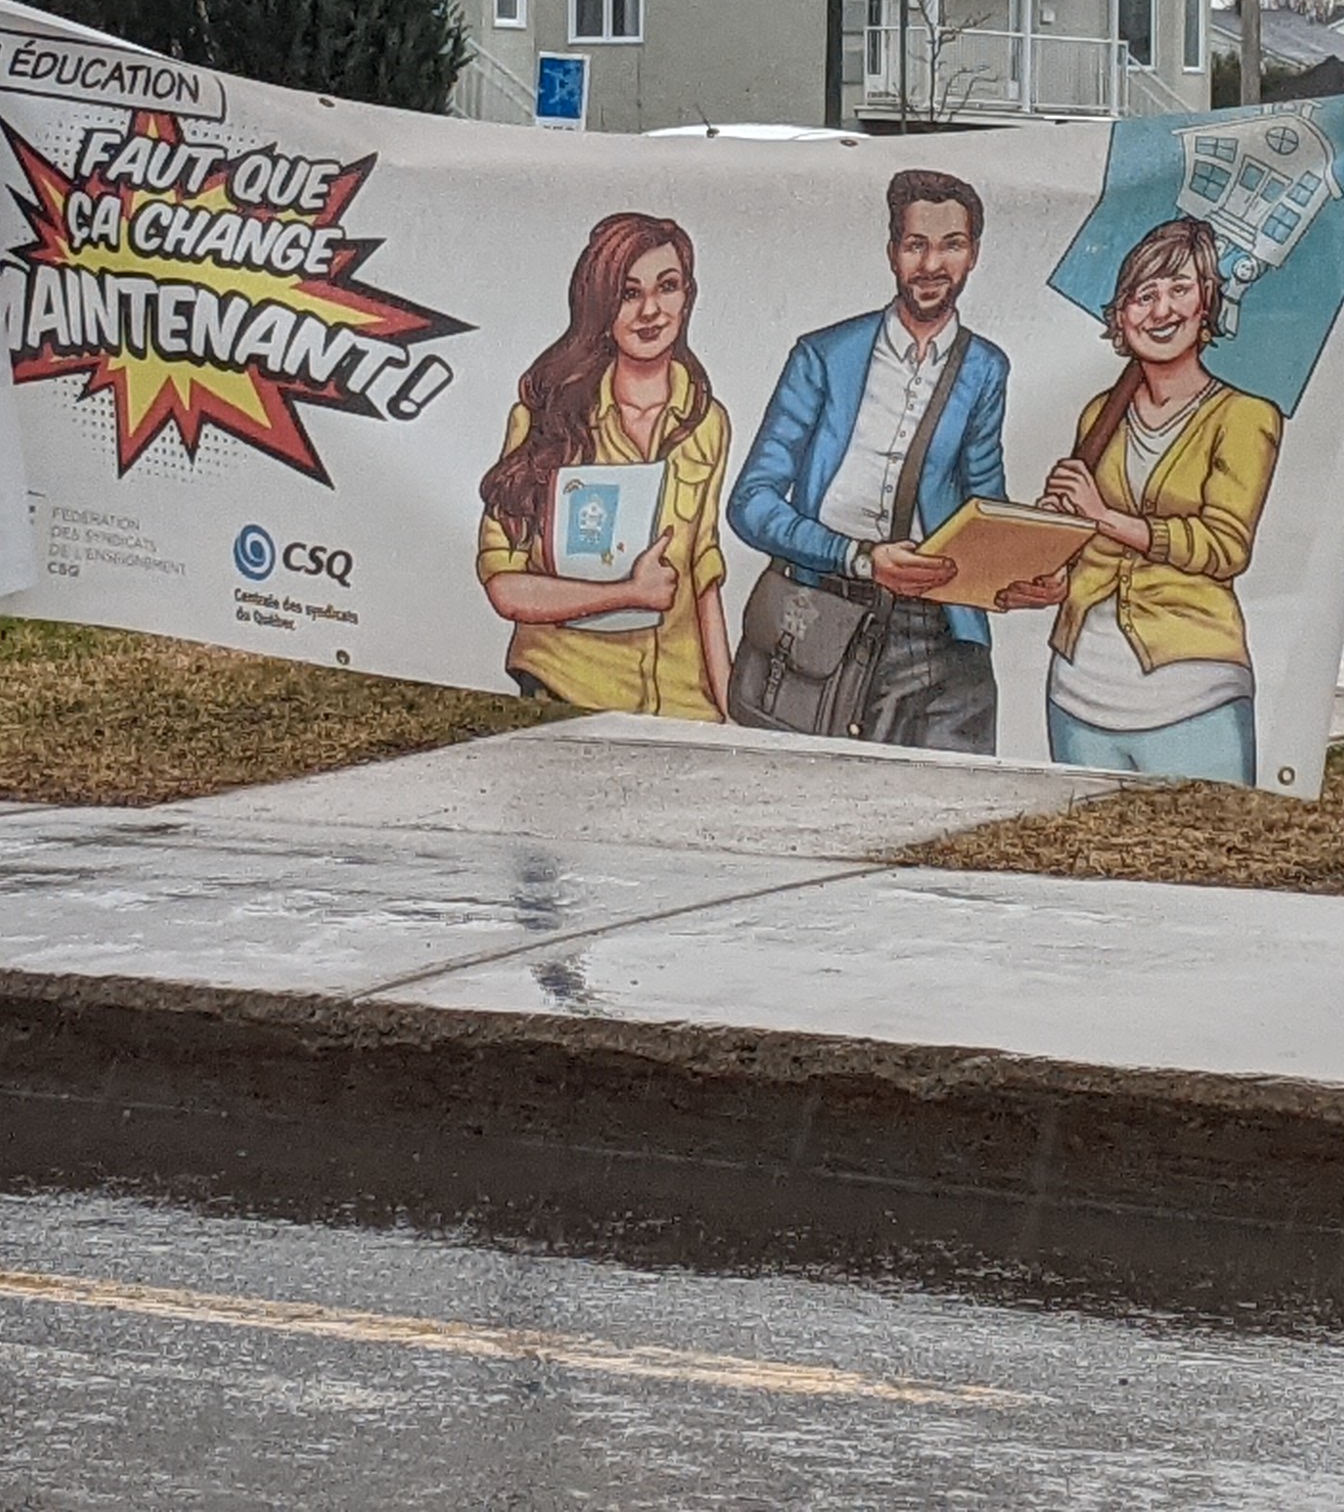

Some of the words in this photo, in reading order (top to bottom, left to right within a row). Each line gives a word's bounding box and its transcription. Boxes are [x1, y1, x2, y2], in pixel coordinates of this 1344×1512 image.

[7, 40, 202, 104] ÉDUCATION
[79, 130, 224, 193] FAUT
[231, 153, 341, 210] QUE
[65, 190, 122, 250] ÇA
[132, 203, 344, 275] CHANGE
[282, 541, 353, 588] CSQ
